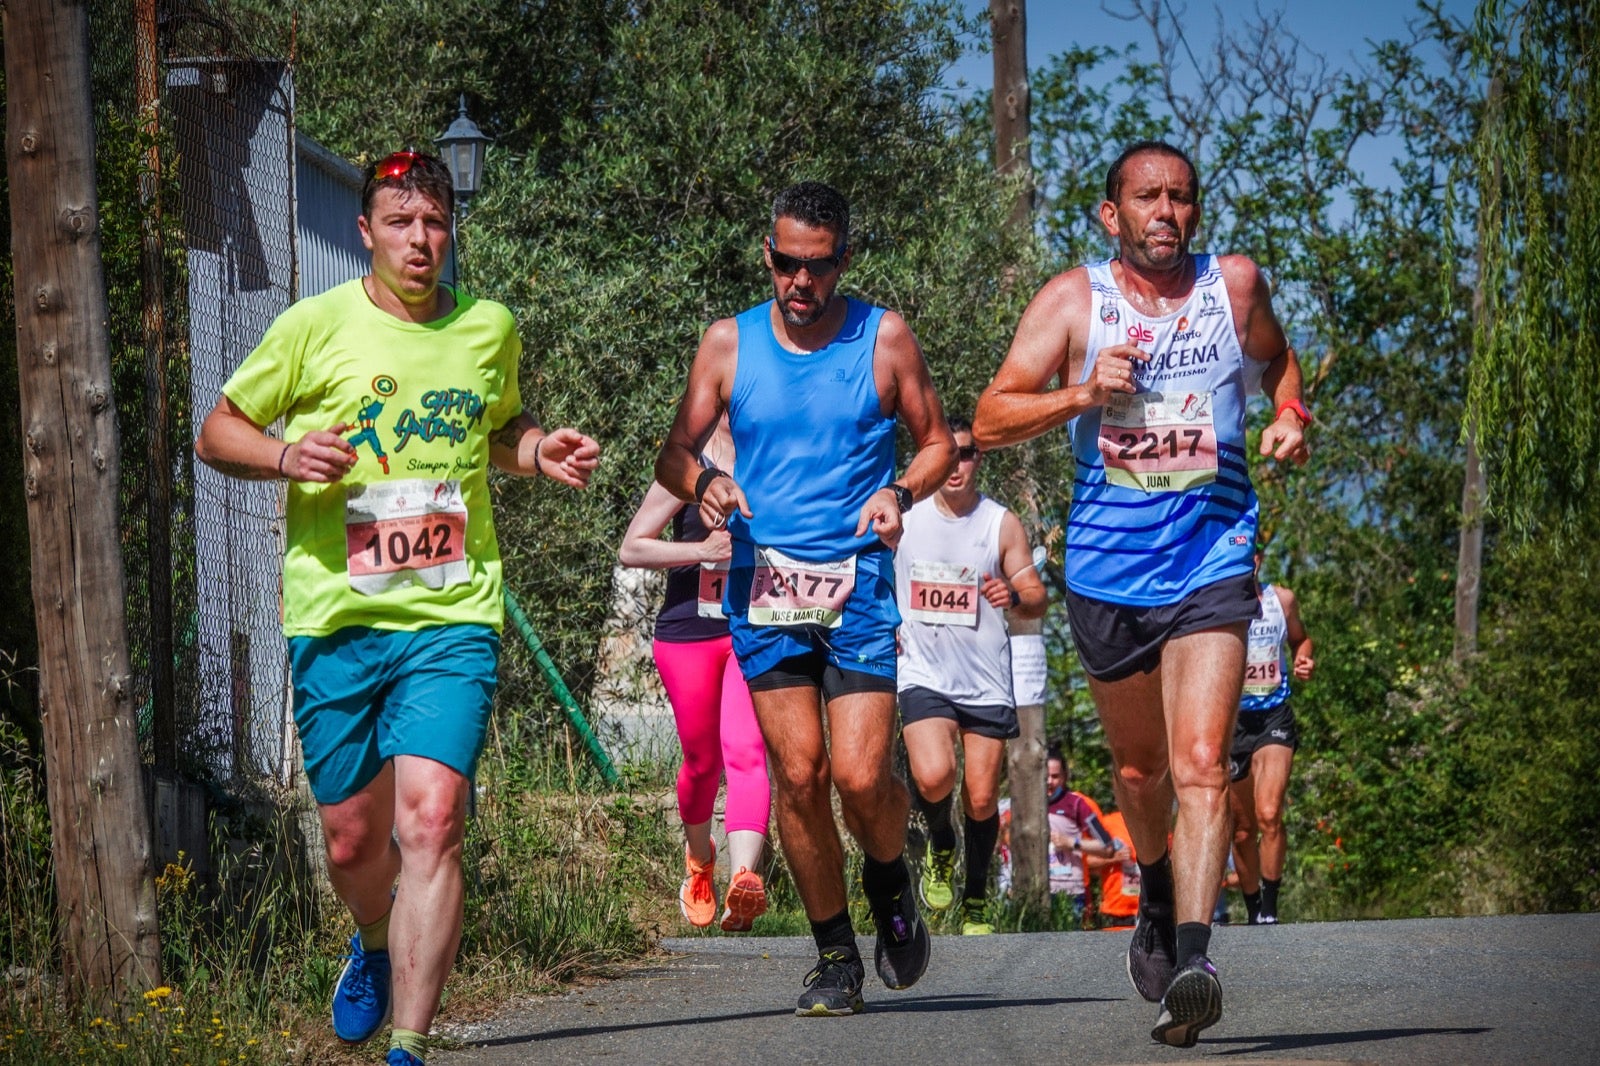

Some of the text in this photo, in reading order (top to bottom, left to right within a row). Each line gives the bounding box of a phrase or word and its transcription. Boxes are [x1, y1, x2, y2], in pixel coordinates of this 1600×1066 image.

[1158, 367, 1208, 381] ATLETISMO
[1117, 429, 1203, 460] 2217
[407, 458, 450, 474] Siempre
[1146, 475, 1170, 488] JUAN
[365, 523, 452, 567] 1042
[768, 571, 844, 598] 2177
[918, 588, 970, 609] 1044
[793, 609, 826, 622] MANUEL
[1246, 663, 1276, 680] 219
